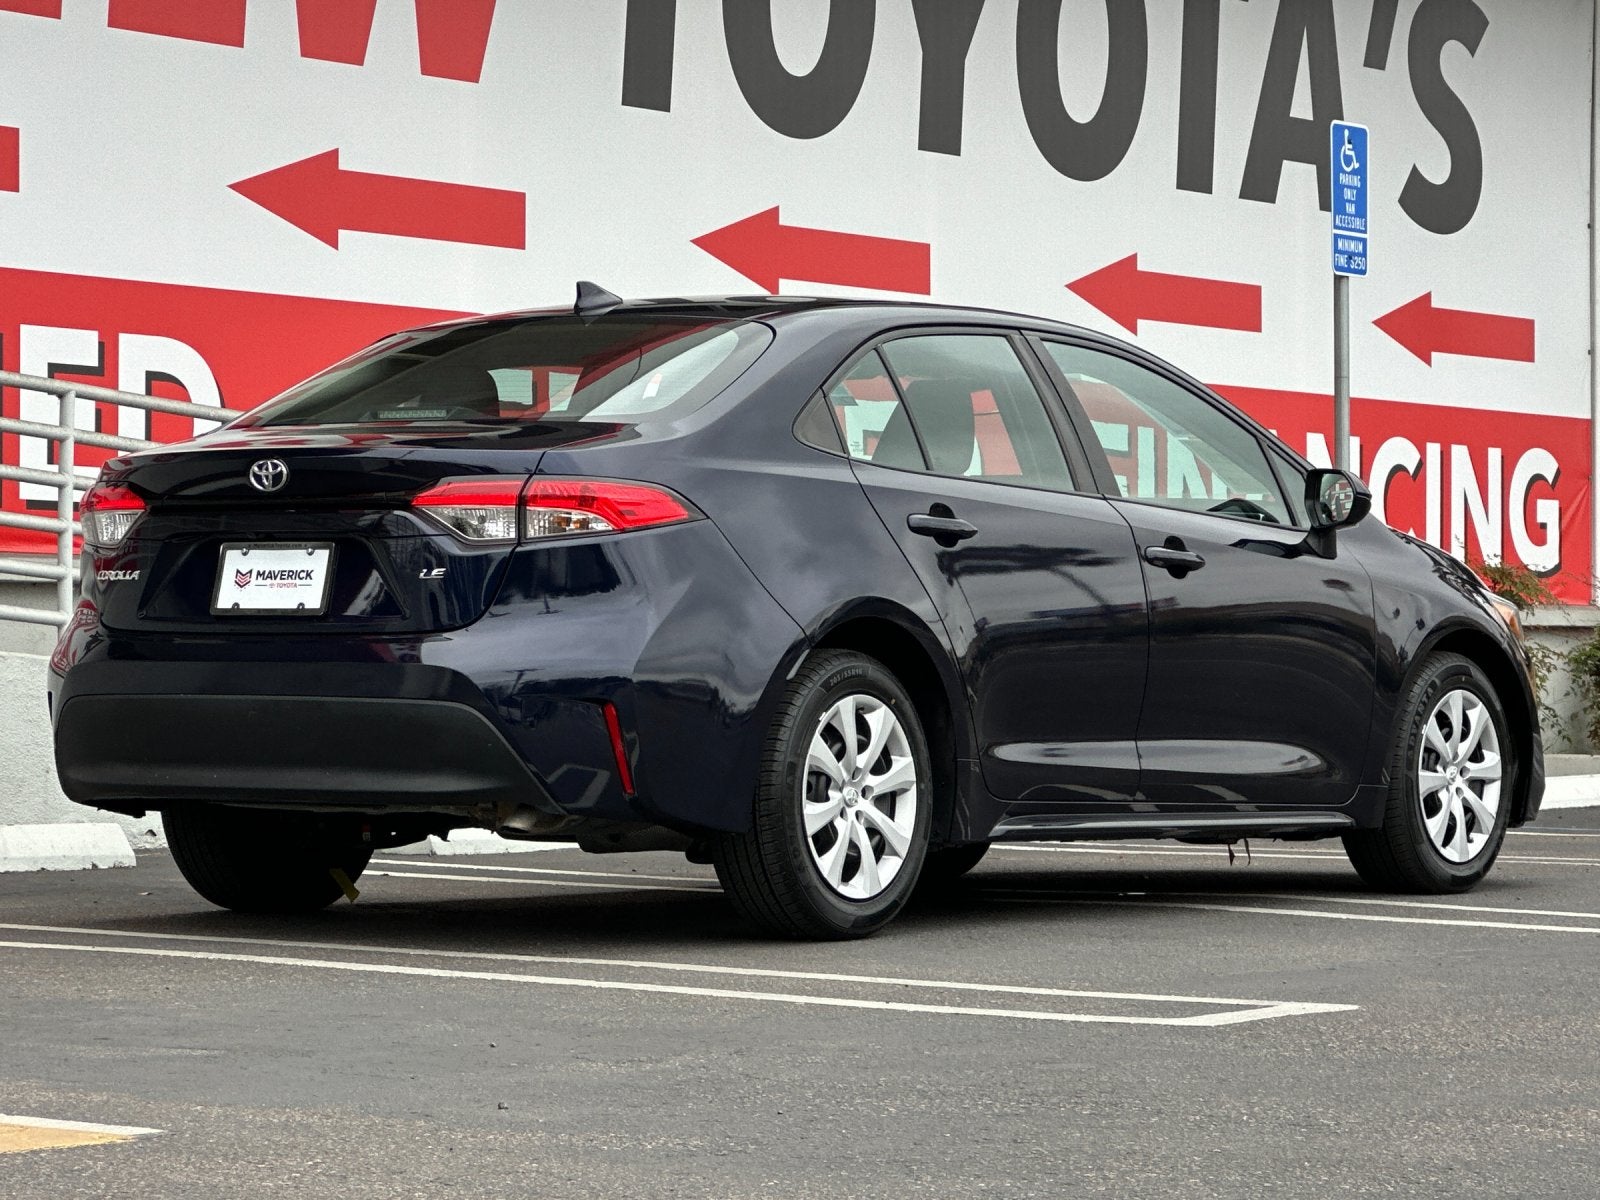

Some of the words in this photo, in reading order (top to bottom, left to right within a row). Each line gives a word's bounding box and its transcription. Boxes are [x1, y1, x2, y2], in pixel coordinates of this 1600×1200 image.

[1339, 173, 1361, 188] PARKING
[1343, 188, 1357, 201] ONLY
[1345, 202, 1356, 214] VAN
[1335, 216, 1366, 231] ACCESSIBLE
[1337, 238, 1363, 254] MINIMUM
[1335, 253, 1348, 267] FINE
[1350, 256, 1366, 270] $250
[255, 569, 314, 581] MAVERICK
[418, 567, 447, 579] LE
